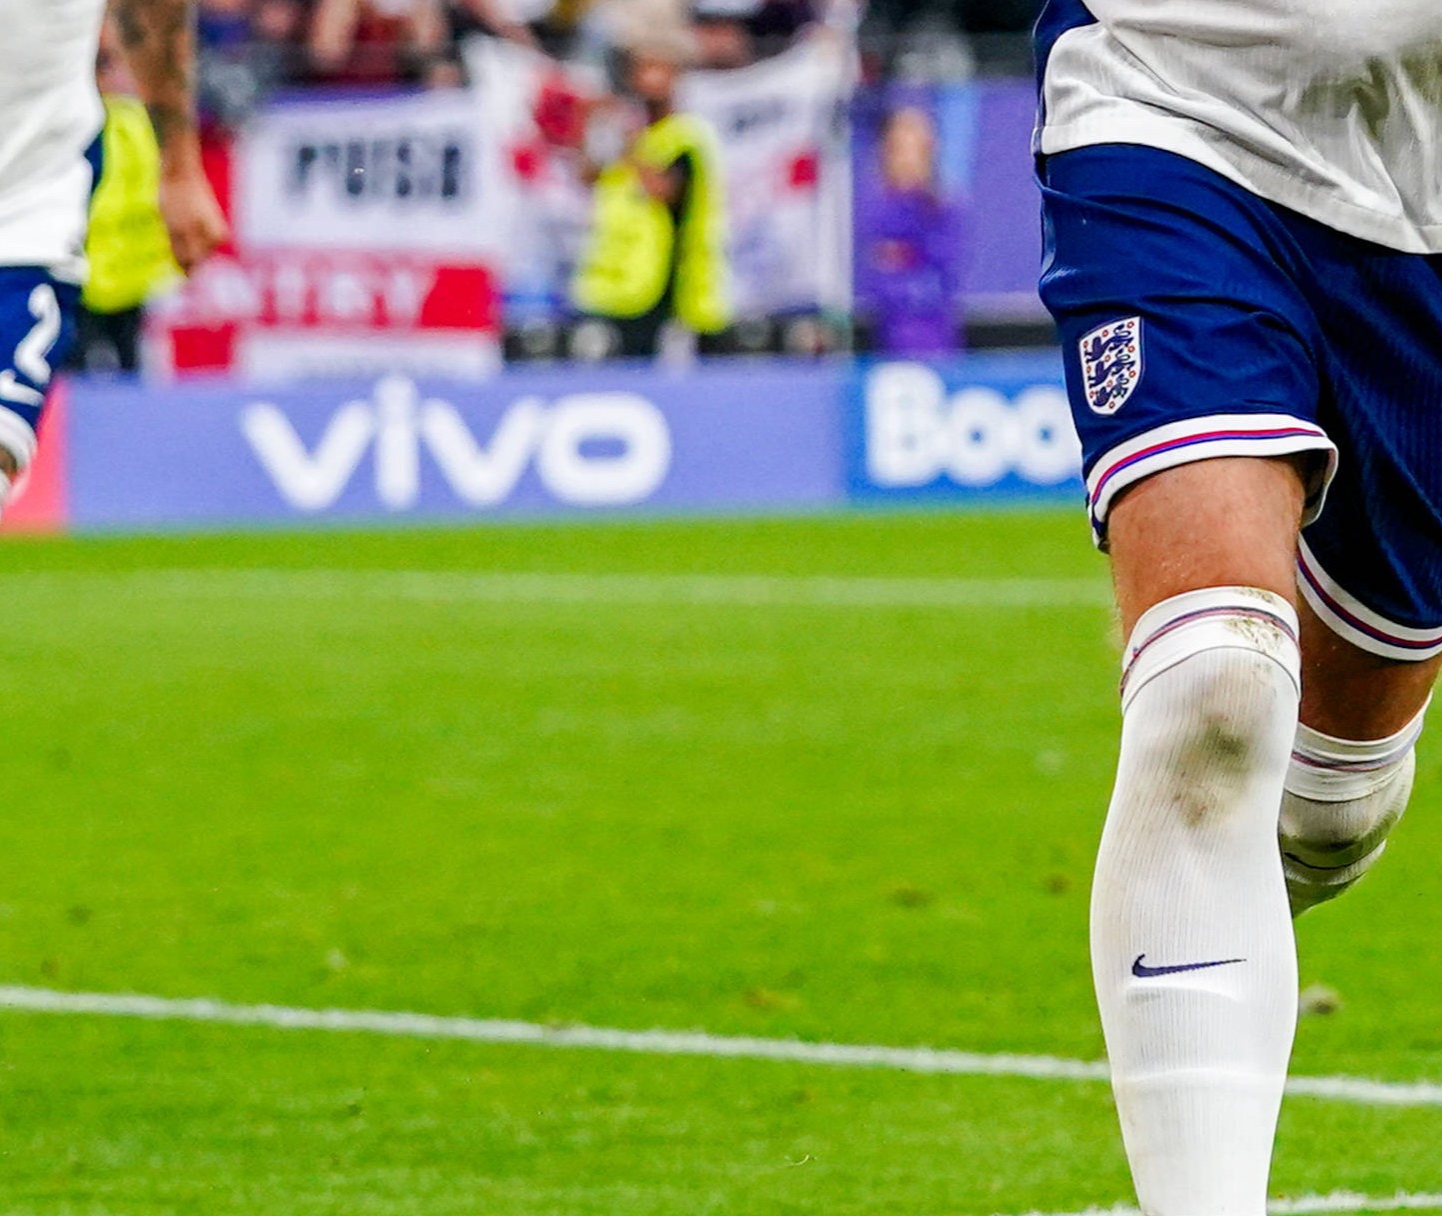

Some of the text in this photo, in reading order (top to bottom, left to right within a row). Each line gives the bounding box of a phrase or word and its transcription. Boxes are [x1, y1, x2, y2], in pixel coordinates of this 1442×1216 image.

[13, 283, 62, 388] 2
[243, 373, 673, 511] vivo
[865, 360, 1084, 487] Boo
